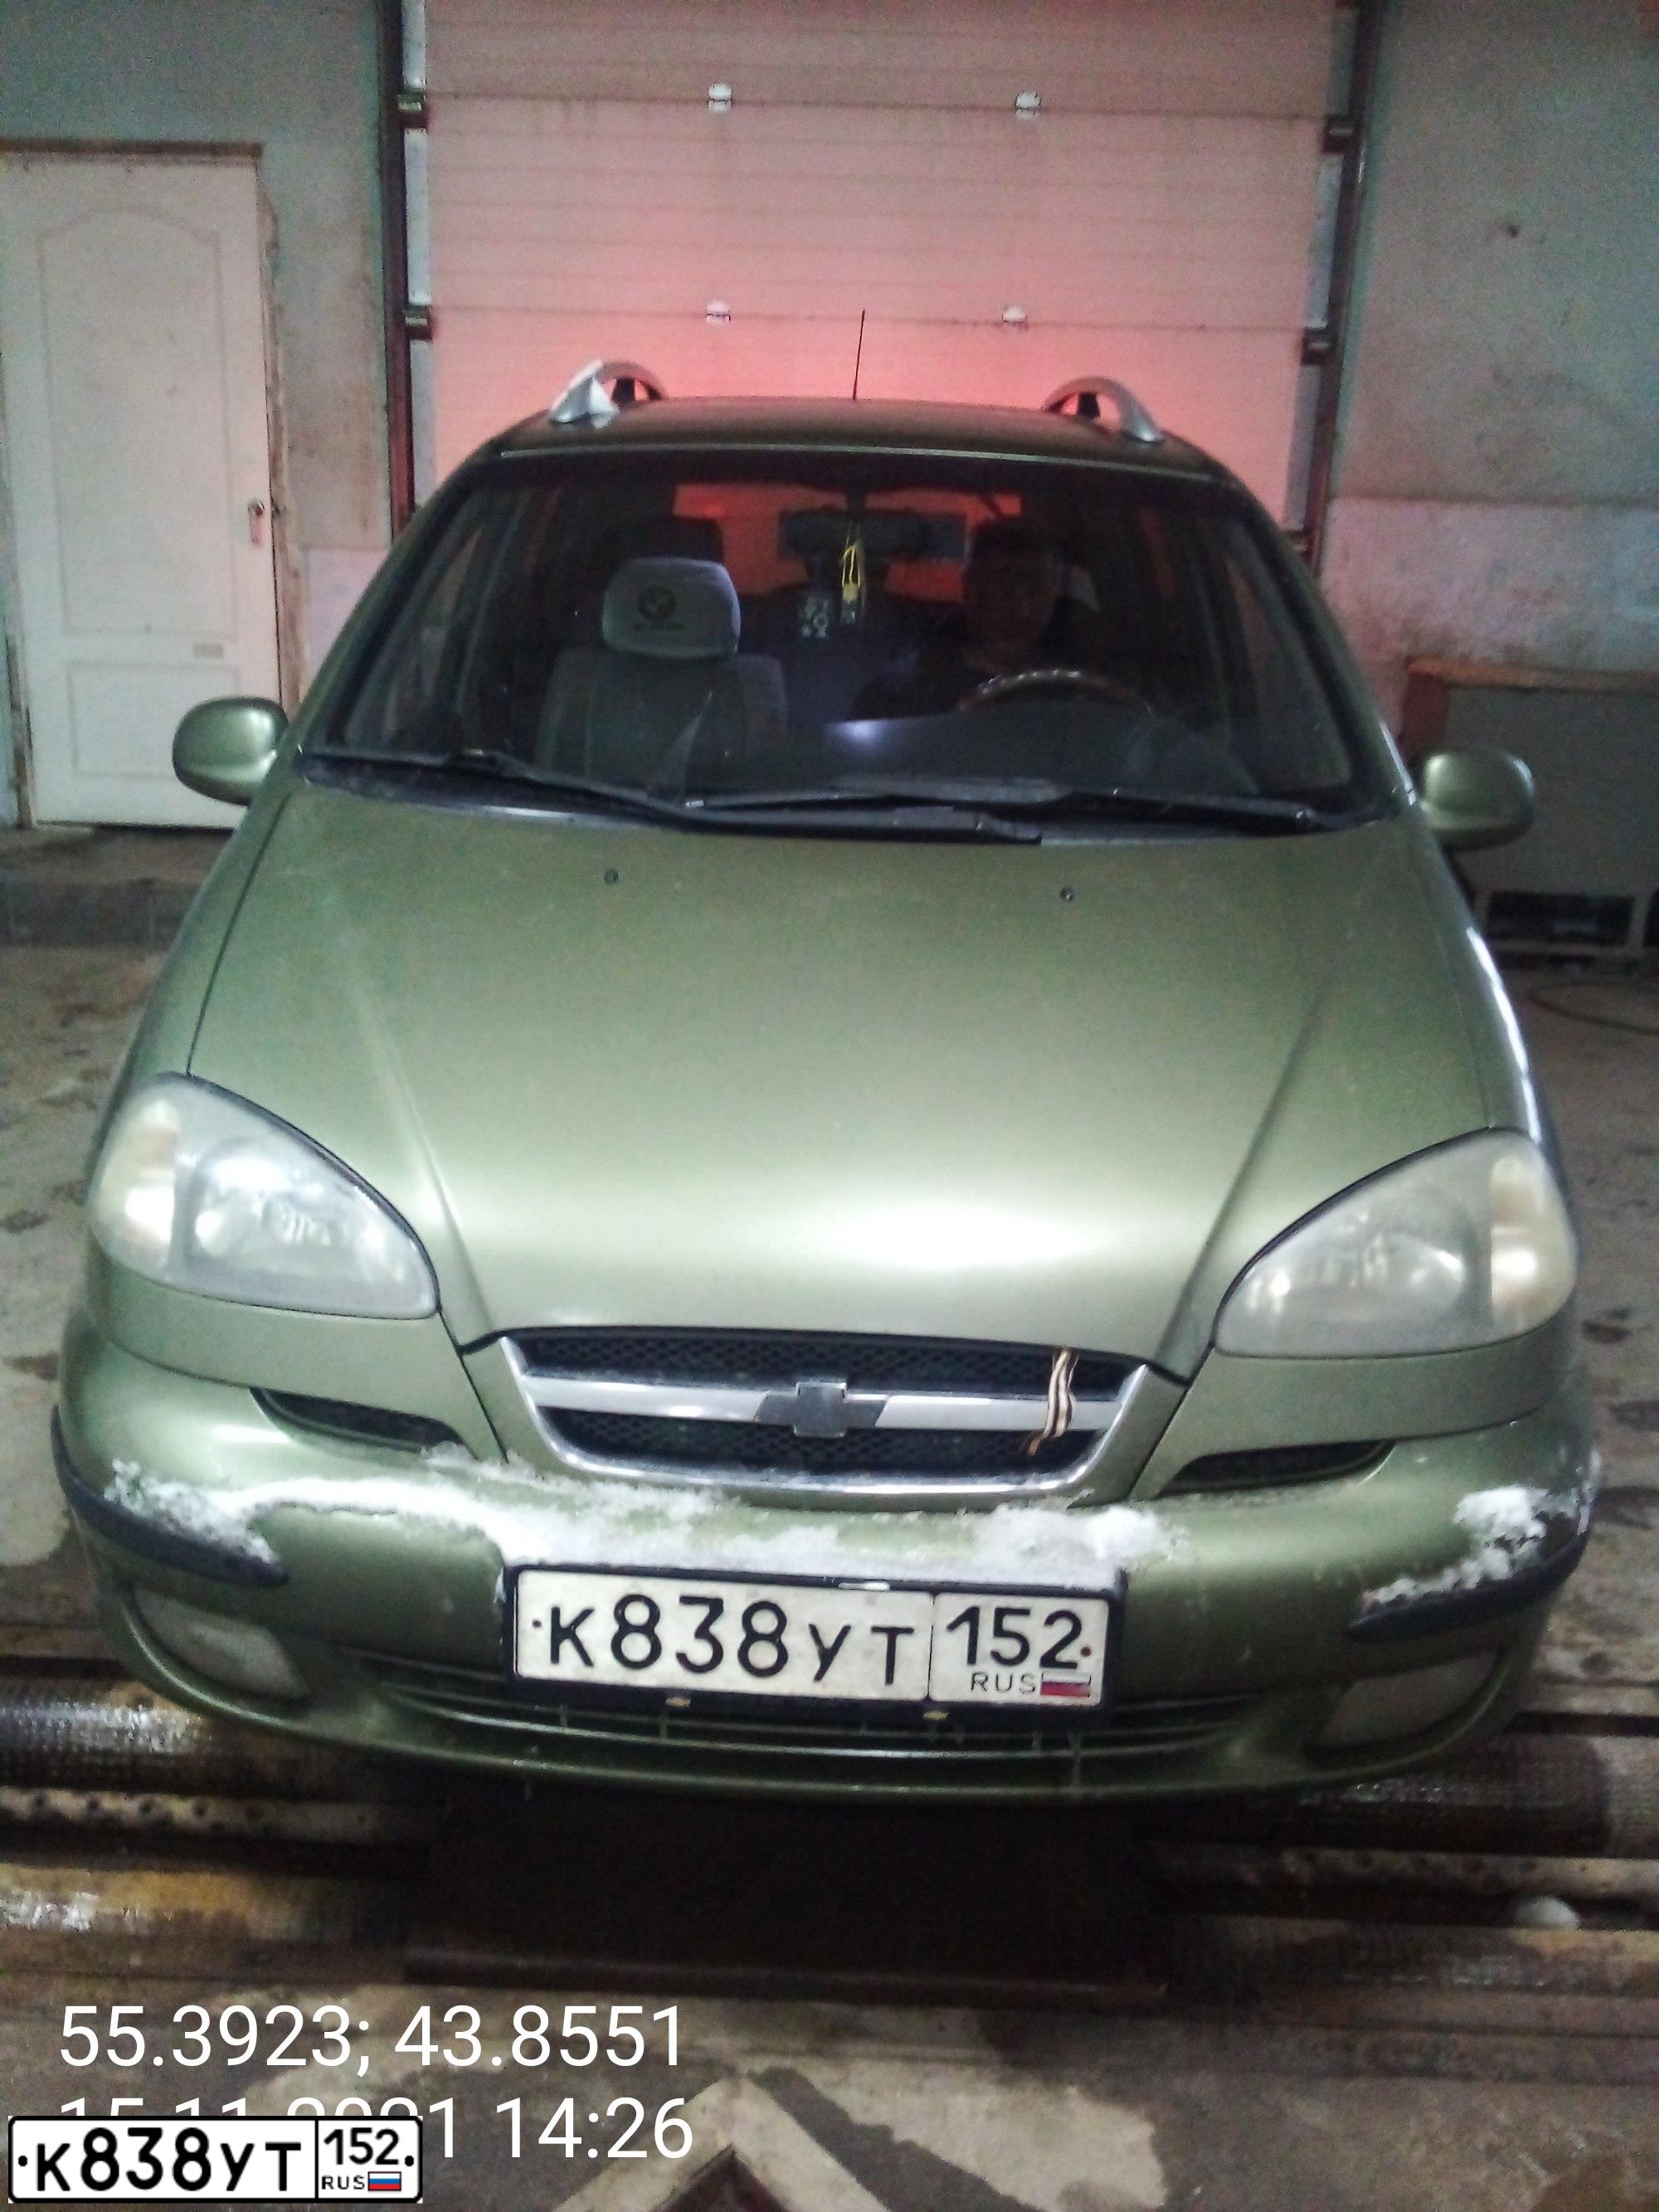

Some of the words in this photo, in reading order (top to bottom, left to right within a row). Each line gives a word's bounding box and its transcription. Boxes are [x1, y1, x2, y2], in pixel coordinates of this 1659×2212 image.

[549, 1593, 916, 1686] К838УТ
[946, 1605, 1082, 1671] 152
[970, 1671, 1036, 1693] RUS
